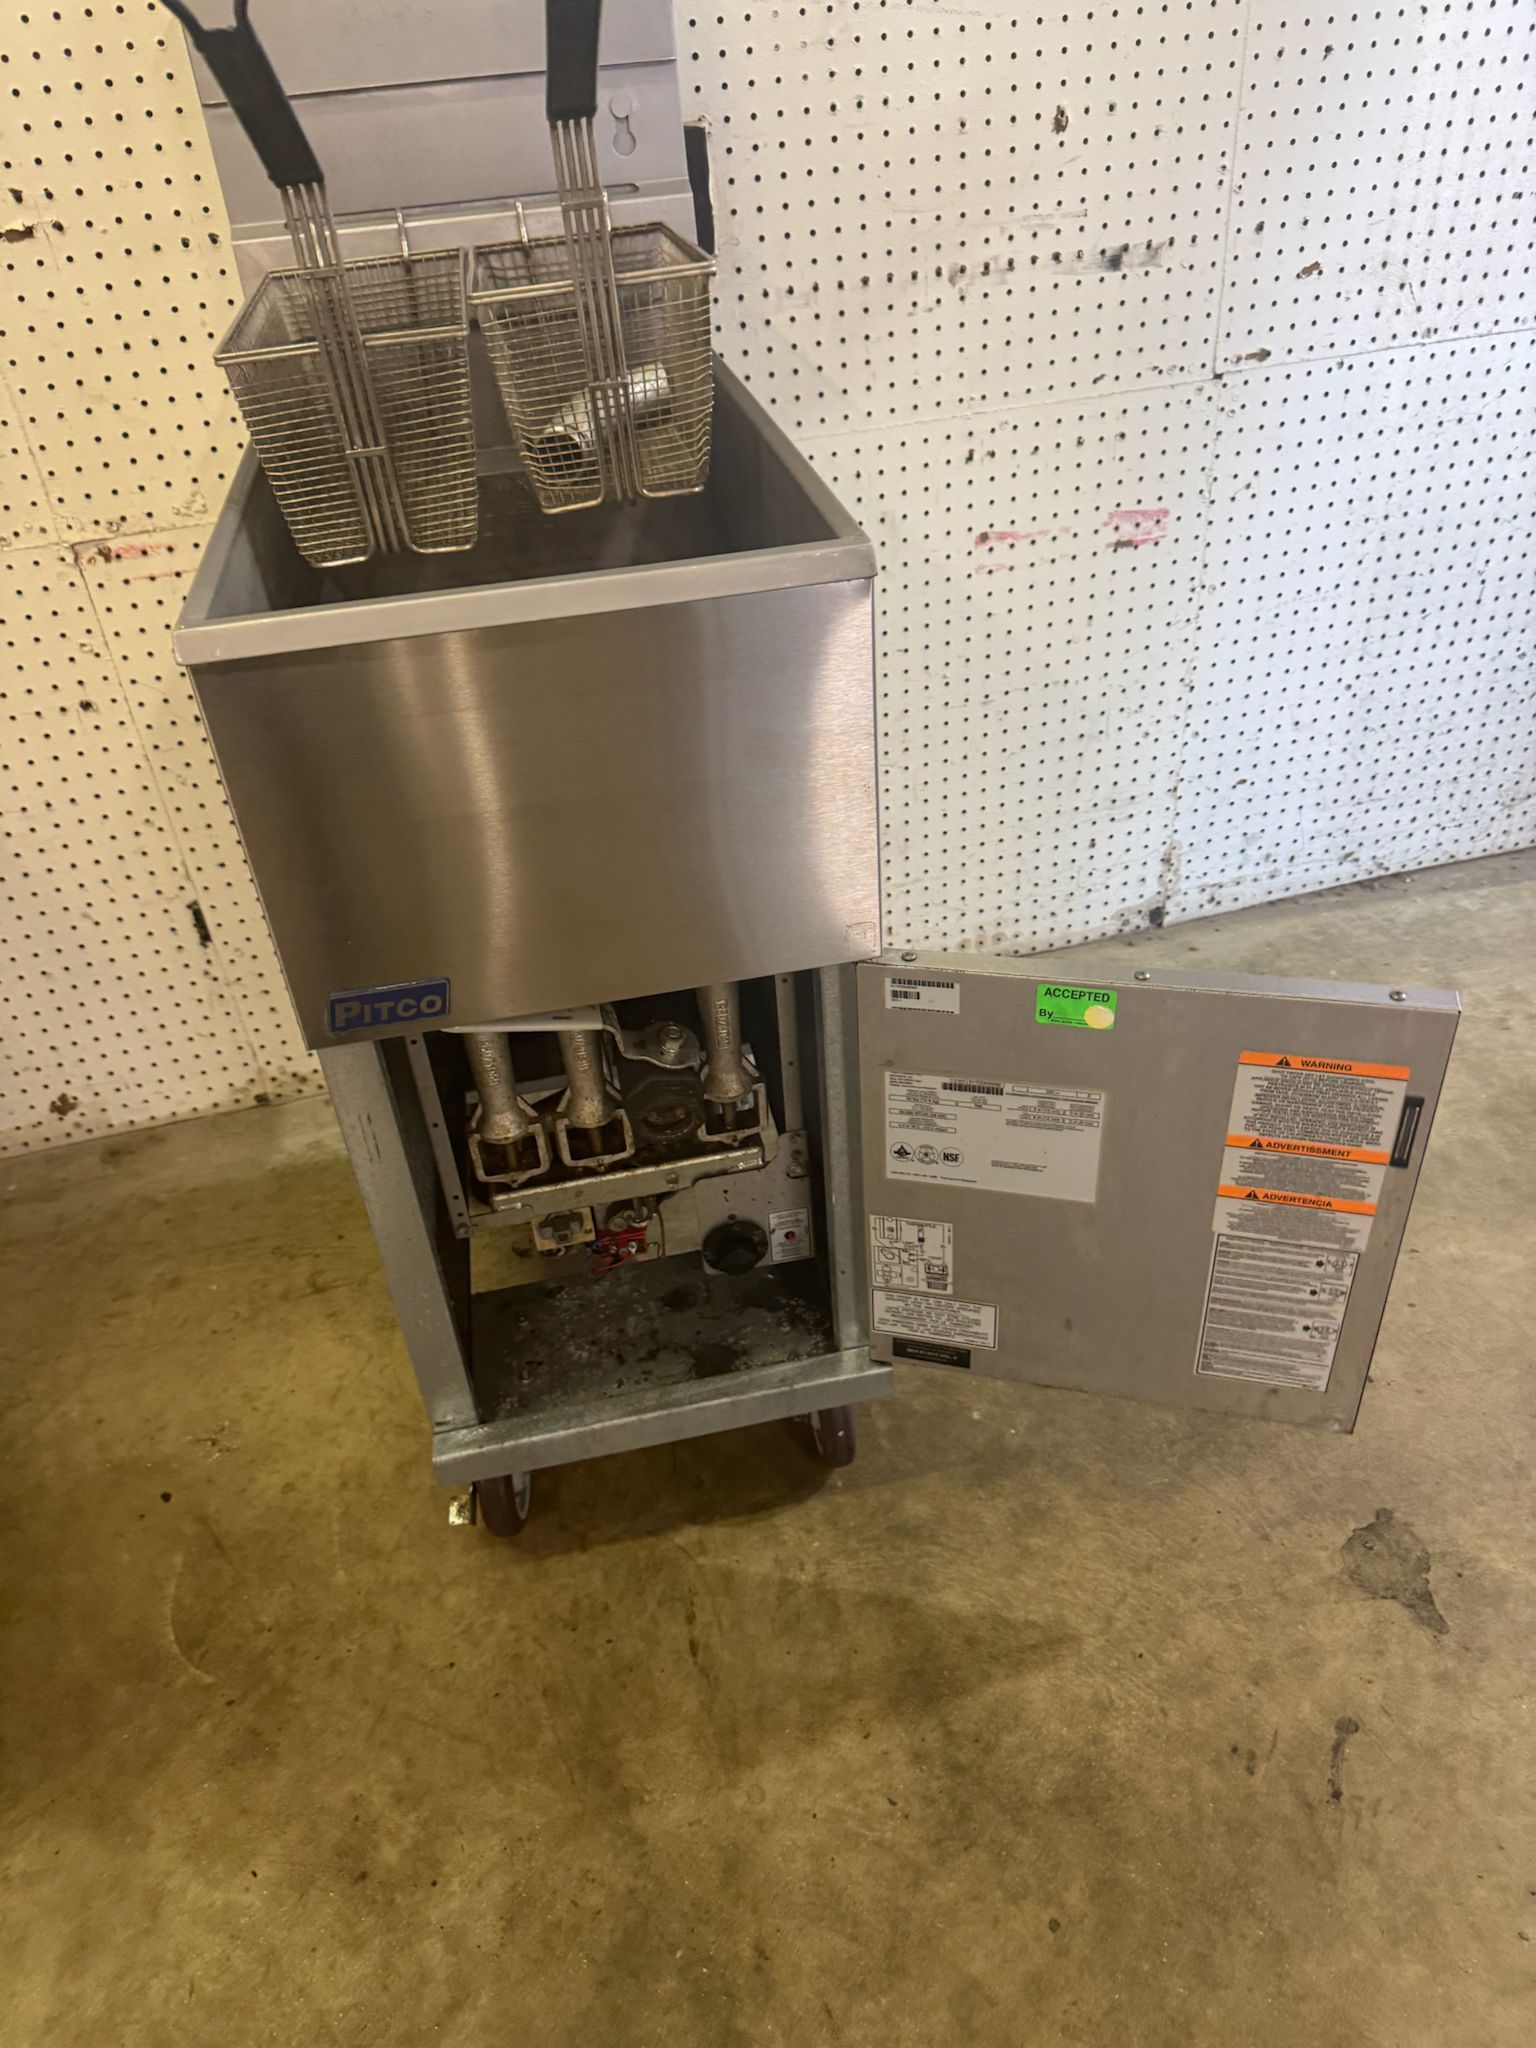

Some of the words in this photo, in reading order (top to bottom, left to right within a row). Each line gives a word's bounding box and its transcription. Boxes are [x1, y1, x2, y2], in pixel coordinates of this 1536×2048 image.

[1044, 987, 1110, 1003] ACCEPTED
[335, 994, 443, 1028] PITCO
[1039, 1008, 1054, 1019] By
[1301, 1059, 1352, 1071] WARNING
[943, 1152, 959, 1163] NSF
[1262, 1193, 1333, 1207] ADVERTENCIA
